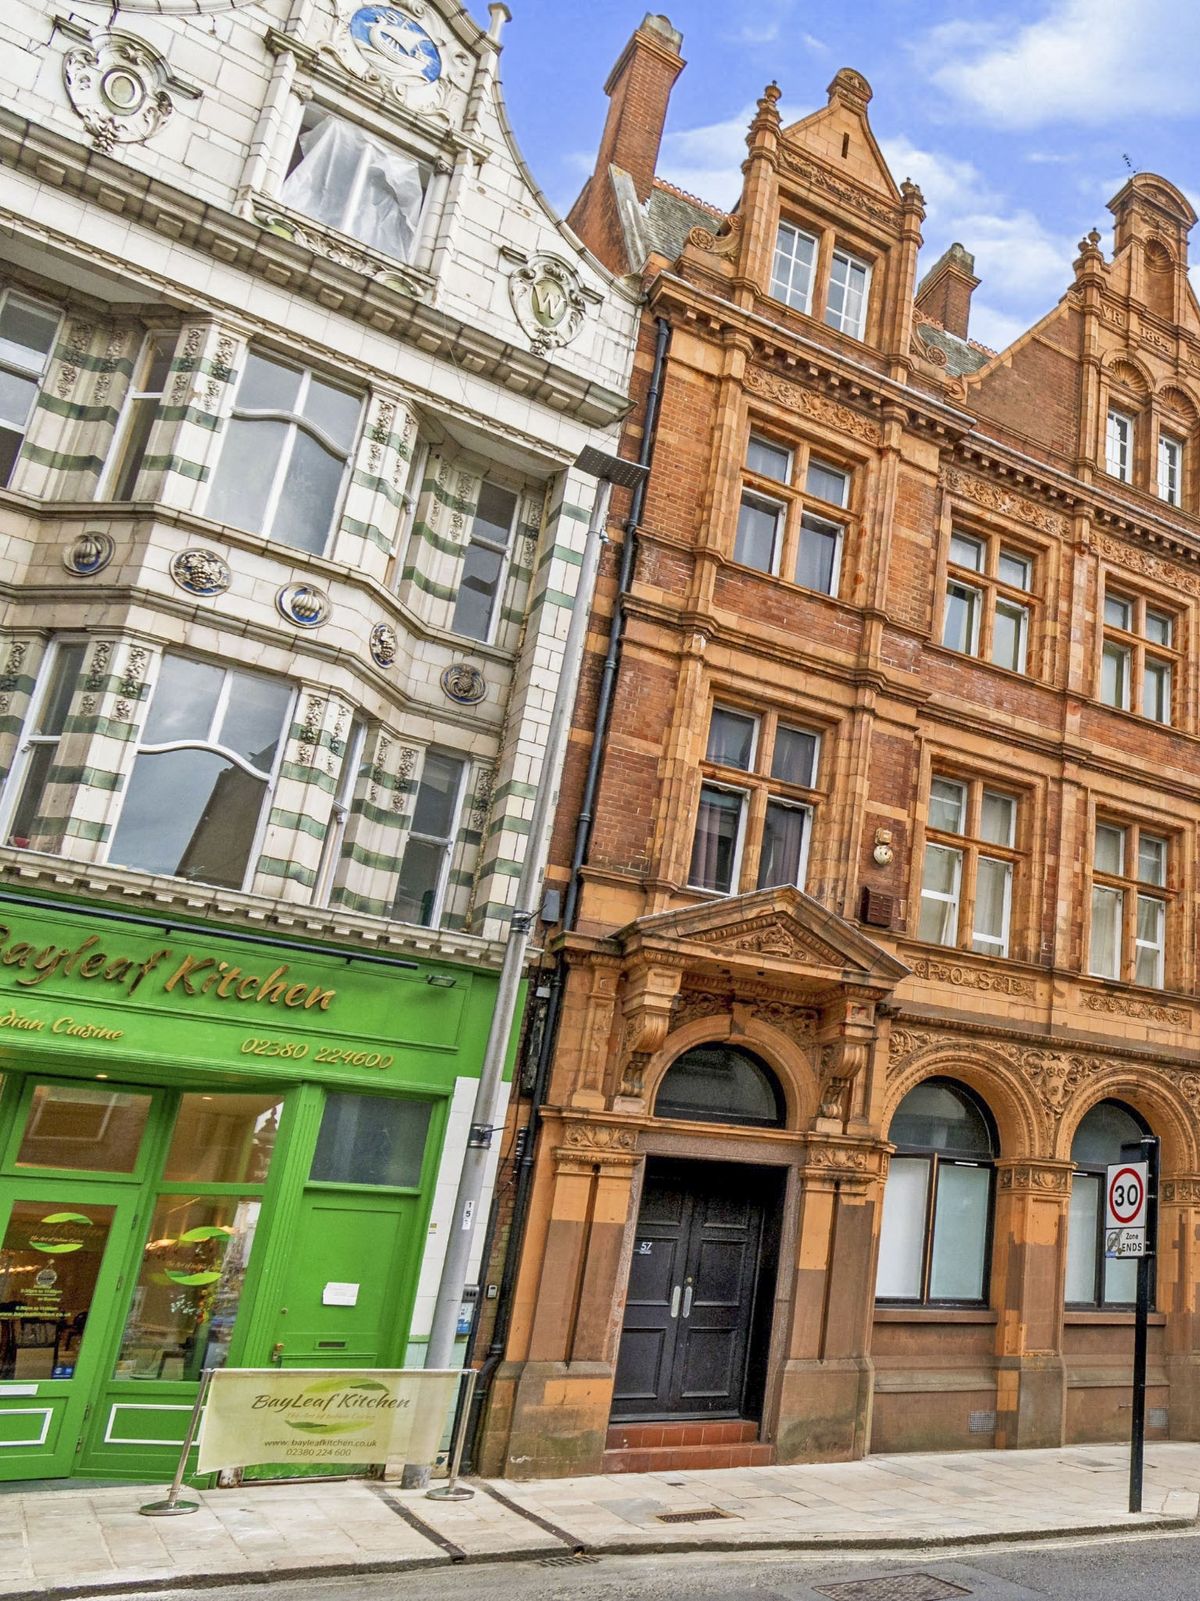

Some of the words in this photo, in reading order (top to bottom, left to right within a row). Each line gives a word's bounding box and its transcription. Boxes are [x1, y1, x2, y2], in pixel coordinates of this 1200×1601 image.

[164, 953, 337, 1011] Kitchen
[928, 961, 1015, 995] POST
[52, 1016, 124, 1041] Cuisine
[241, 1037, 309, 1060] 02380
[314, 1046, 394, 1069] 224600
[1115, 1184, 1138, 1207] 30
[640, 1241, 652, 1251] 57
[1122, 1242, 1143, 1252] ENDS
[1125, 1232, 1139, 1240] Zone
[251, 1393, 339, 1414] BayLeaf
[337, 1392, 411, 1410] Kitchen
[286, 1448, 315, 1457] 02380
[315, 1448, 333, 1457] 224
[334, 1448, 352, 1457] 600
